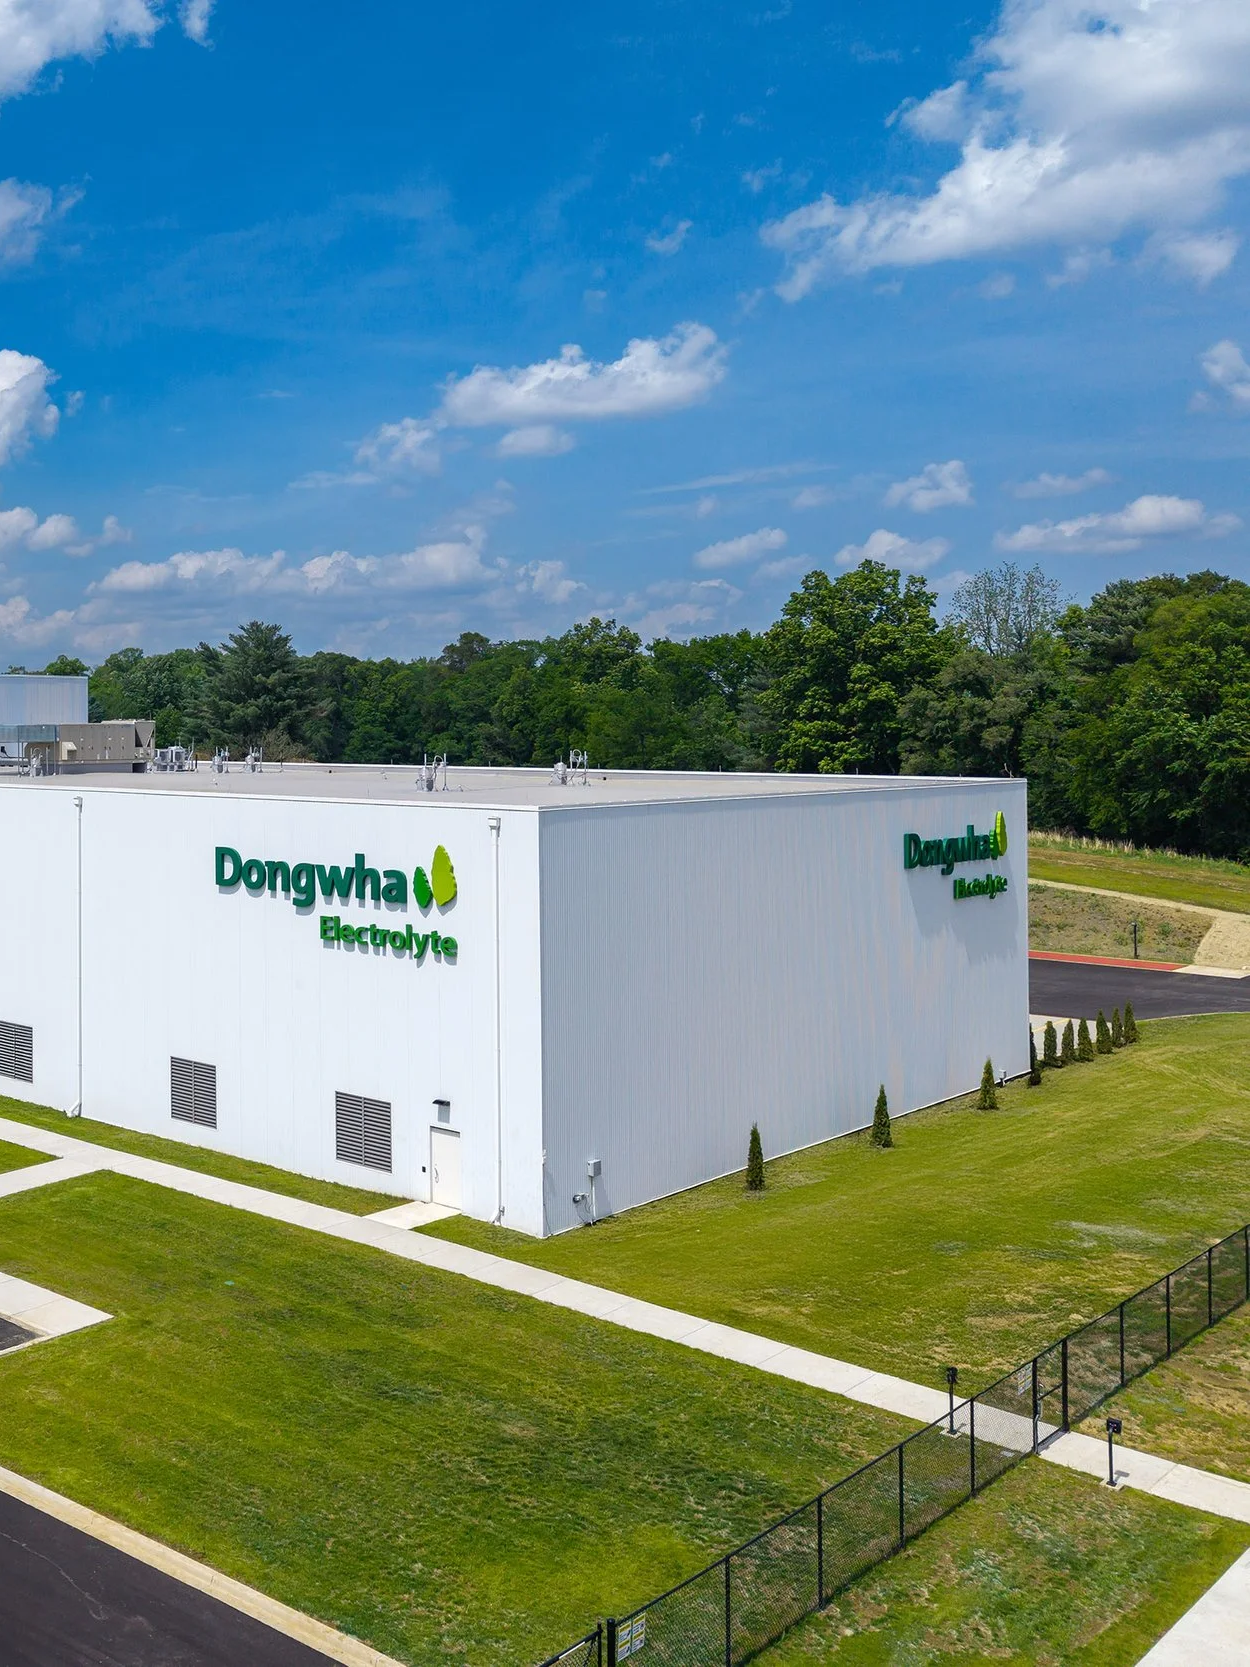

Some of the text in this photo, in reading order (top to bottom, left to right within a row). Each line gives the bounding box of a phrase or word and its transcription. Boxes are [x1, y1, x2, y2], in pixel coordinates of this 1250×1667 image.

[904, 825, 990, 875] Dongwha
[215, 846, 408, 907] Dongwha
[320, 915, 458, 959] Electrolyte
